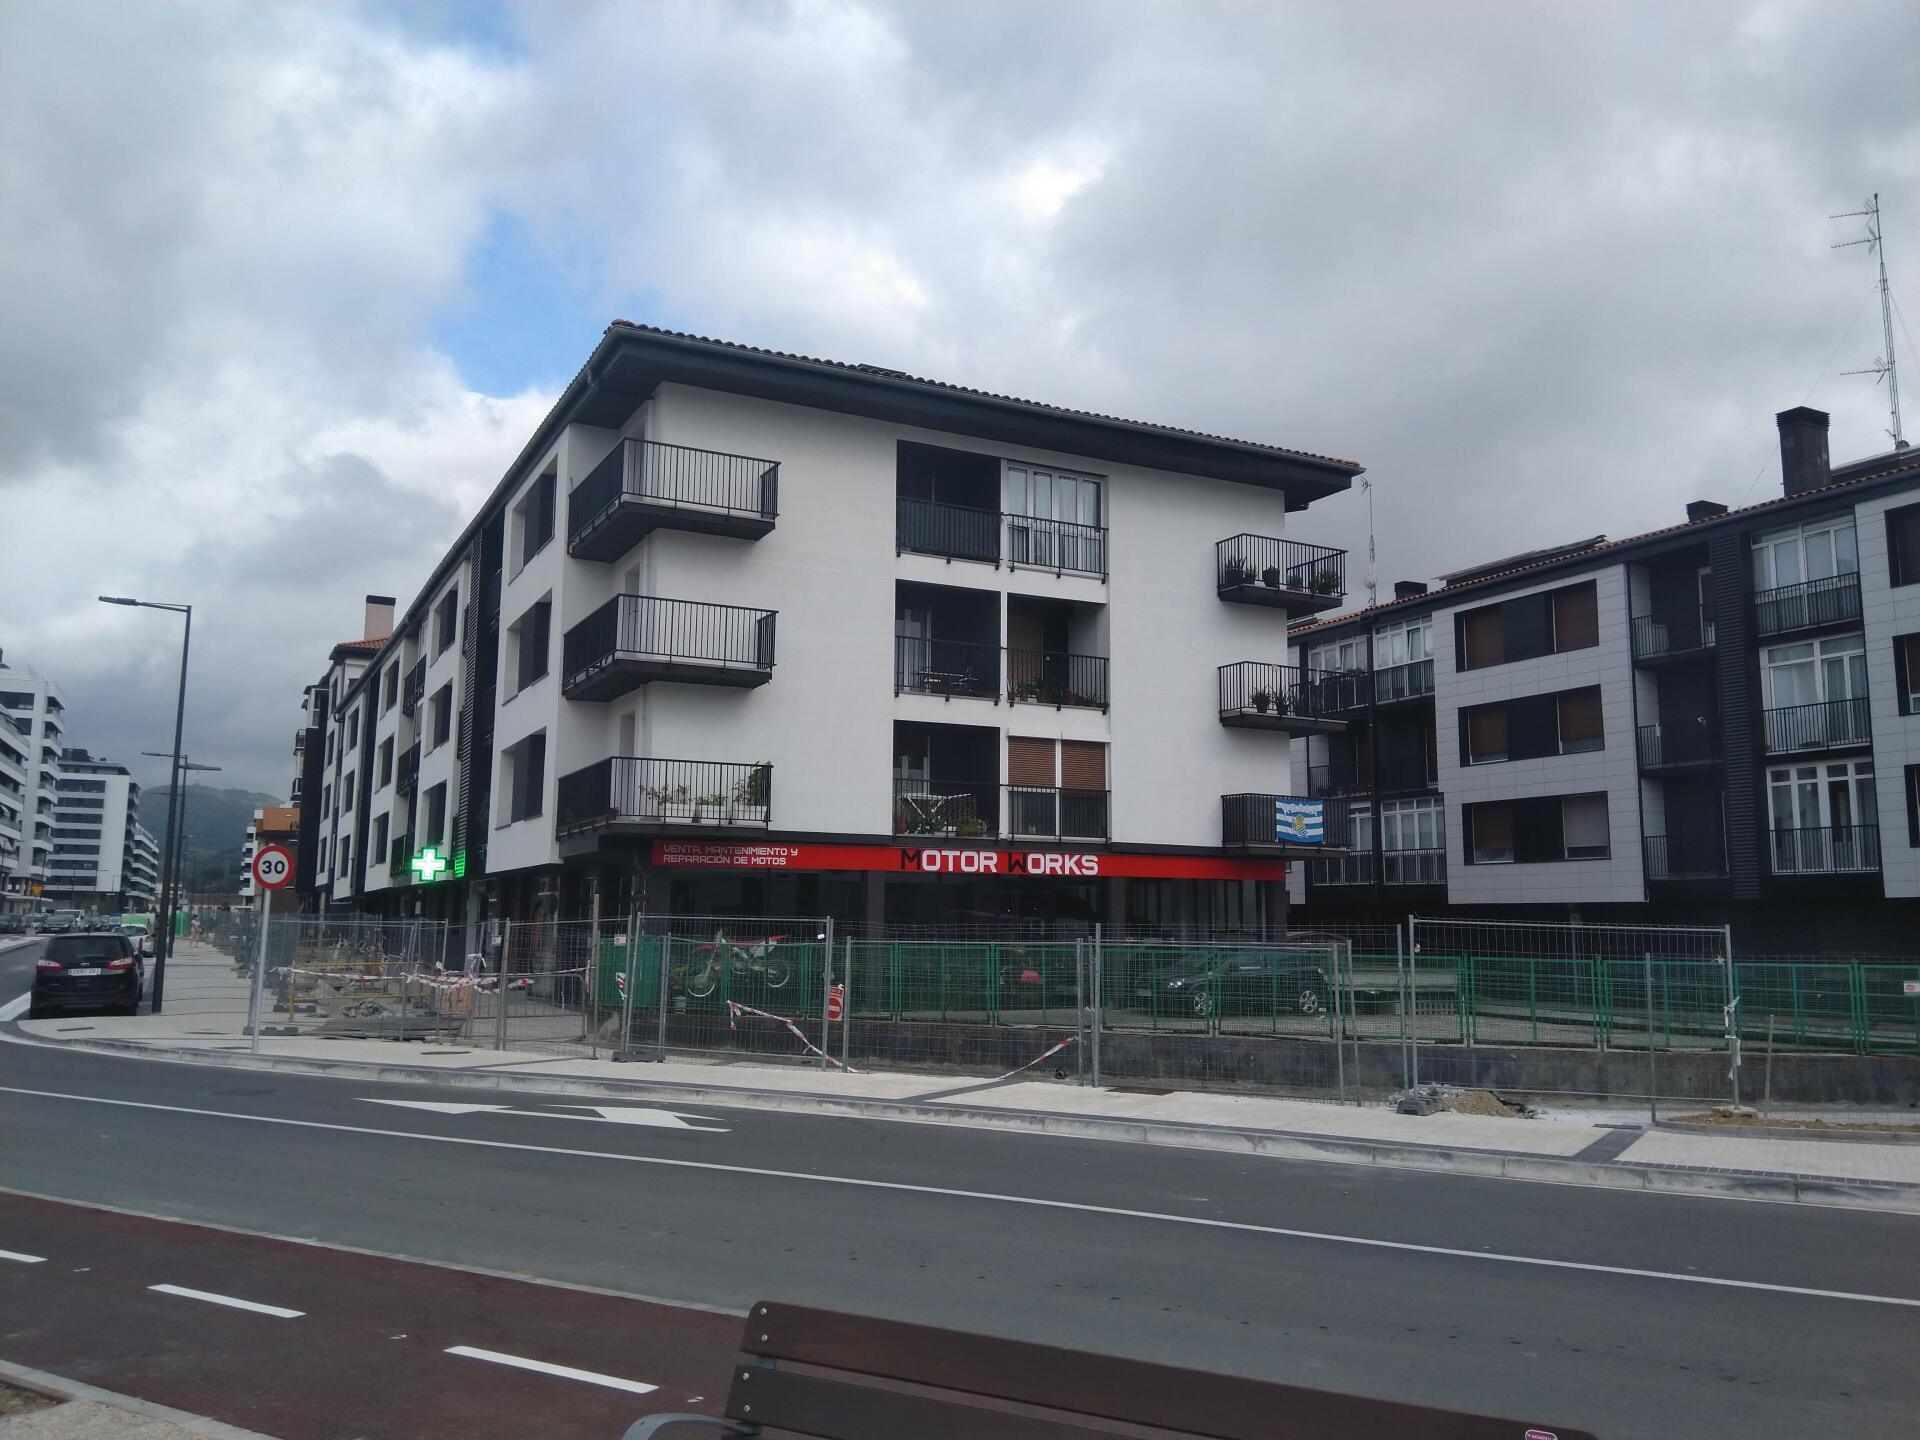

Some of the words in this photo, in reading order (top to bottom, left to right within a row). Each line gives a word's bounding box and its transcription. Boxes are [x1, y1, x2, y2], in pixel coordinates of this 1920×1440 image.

[705, 846, 788, 856] MANTENIMIENTO
[733, 856, 748, 864] DE
[751, 857, 787, 865] MOTOS
[900, 848, 997, 873] MOTOR
[1008, 851, 1099, 876] WORKS
[262, 860, 285, 874] 30
